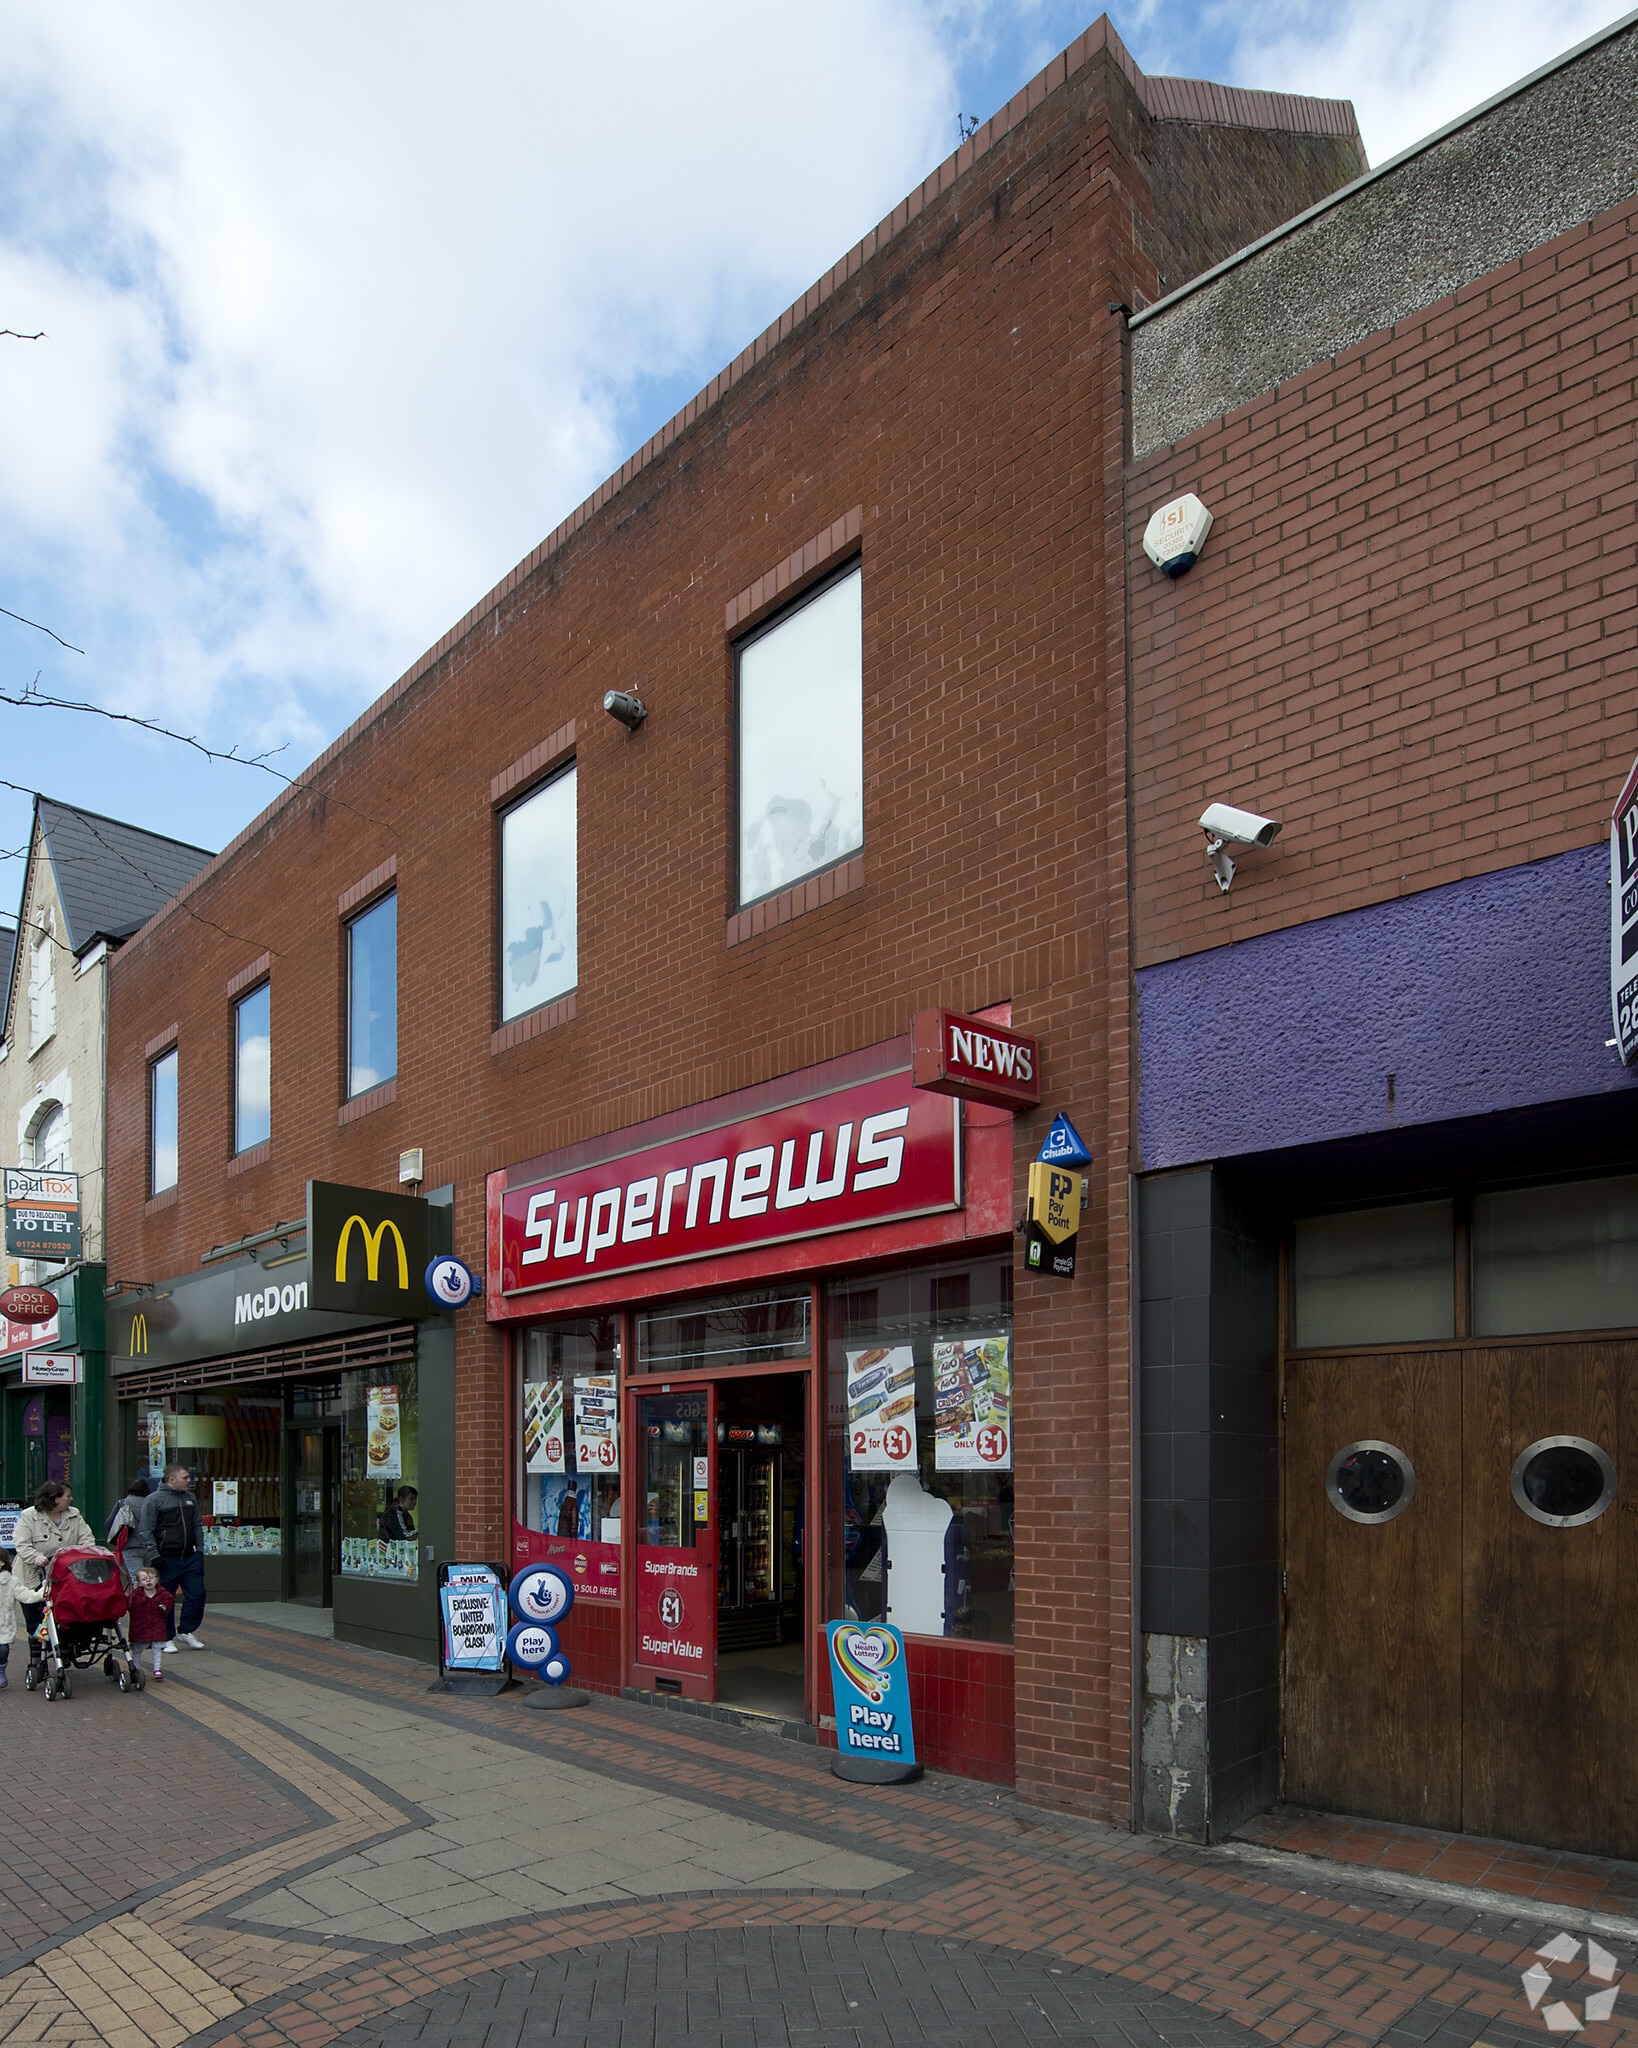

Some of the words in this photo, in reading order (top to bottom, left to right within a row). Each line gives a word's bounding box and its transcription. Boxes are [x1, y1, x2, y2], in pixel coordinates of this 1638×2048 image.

[1153, 521, 1195, 547] SECURITY
[1620, 979, 1638, 1003] TELE
[1620, 994, 1638, 1040] 28
[950, 1026, 1034, 1082] NEWS
[1042, 1145, 1073, 1160] Chubb
[521, 1105, 911, 1266] Supernews
[1049, 1198, 1064, 1216] Pay
[36, 1212, 66, 1220] RELOCATION
[1048, 1212, 1070, 1229] Point
[12, 1218, 38, 1231] TO
[43, 1220, 75, 1233] LET
[16, 1240, 40, 1249] 01724
[42, 1241, 71, 1250] 870520
[13, 1293, 45, 1304] POST
[234, 1281, 308, 1325] McDon
[7, 1303, 50, 1315] OFFICE
[31, 1365, 69, 1373] MoneyGram
[853, 1431, 867, 1454] 2
[869, 1438, 880, 1449] for
[886, 1430, 908, 1454] £1
[953, 1441, 975, 1449] ONLY
[980, 1430, 1003, 1456] £1
[548, 1450, 560, 1458] FREE
[580, 1444, 588, 1462] 2
[589, 1449, 597, 1458] for
[600, 1443, 614, 1462] £1
[547, 1543, 566, 1556] Mars
[644, 1560, 698, 1577] SuperBrands
[580, 1584, 598, 1594] SOLD
[599, 1586, 618, 1596] HERE
[529, 1604, 550, 1614] National
[662, 1597, 680, 1624] £1
[460, 1611, 484, 1623] UNITED
[452, 1623, 496, 1636] BOARDROOM
[464, 1636, 486, 1649] CLASH
[522, 1637, 544, 1647] Play
[642, 1635, 703, 1659] SuperValue
[854, 1644, 878, 1652] Health
[522, 1645, 545, 1655] here
[854, 1650, 880, 1659] Lottery
[850, 1705, 893, 1732] Play
[848, 1728, 900, 1752] here!
